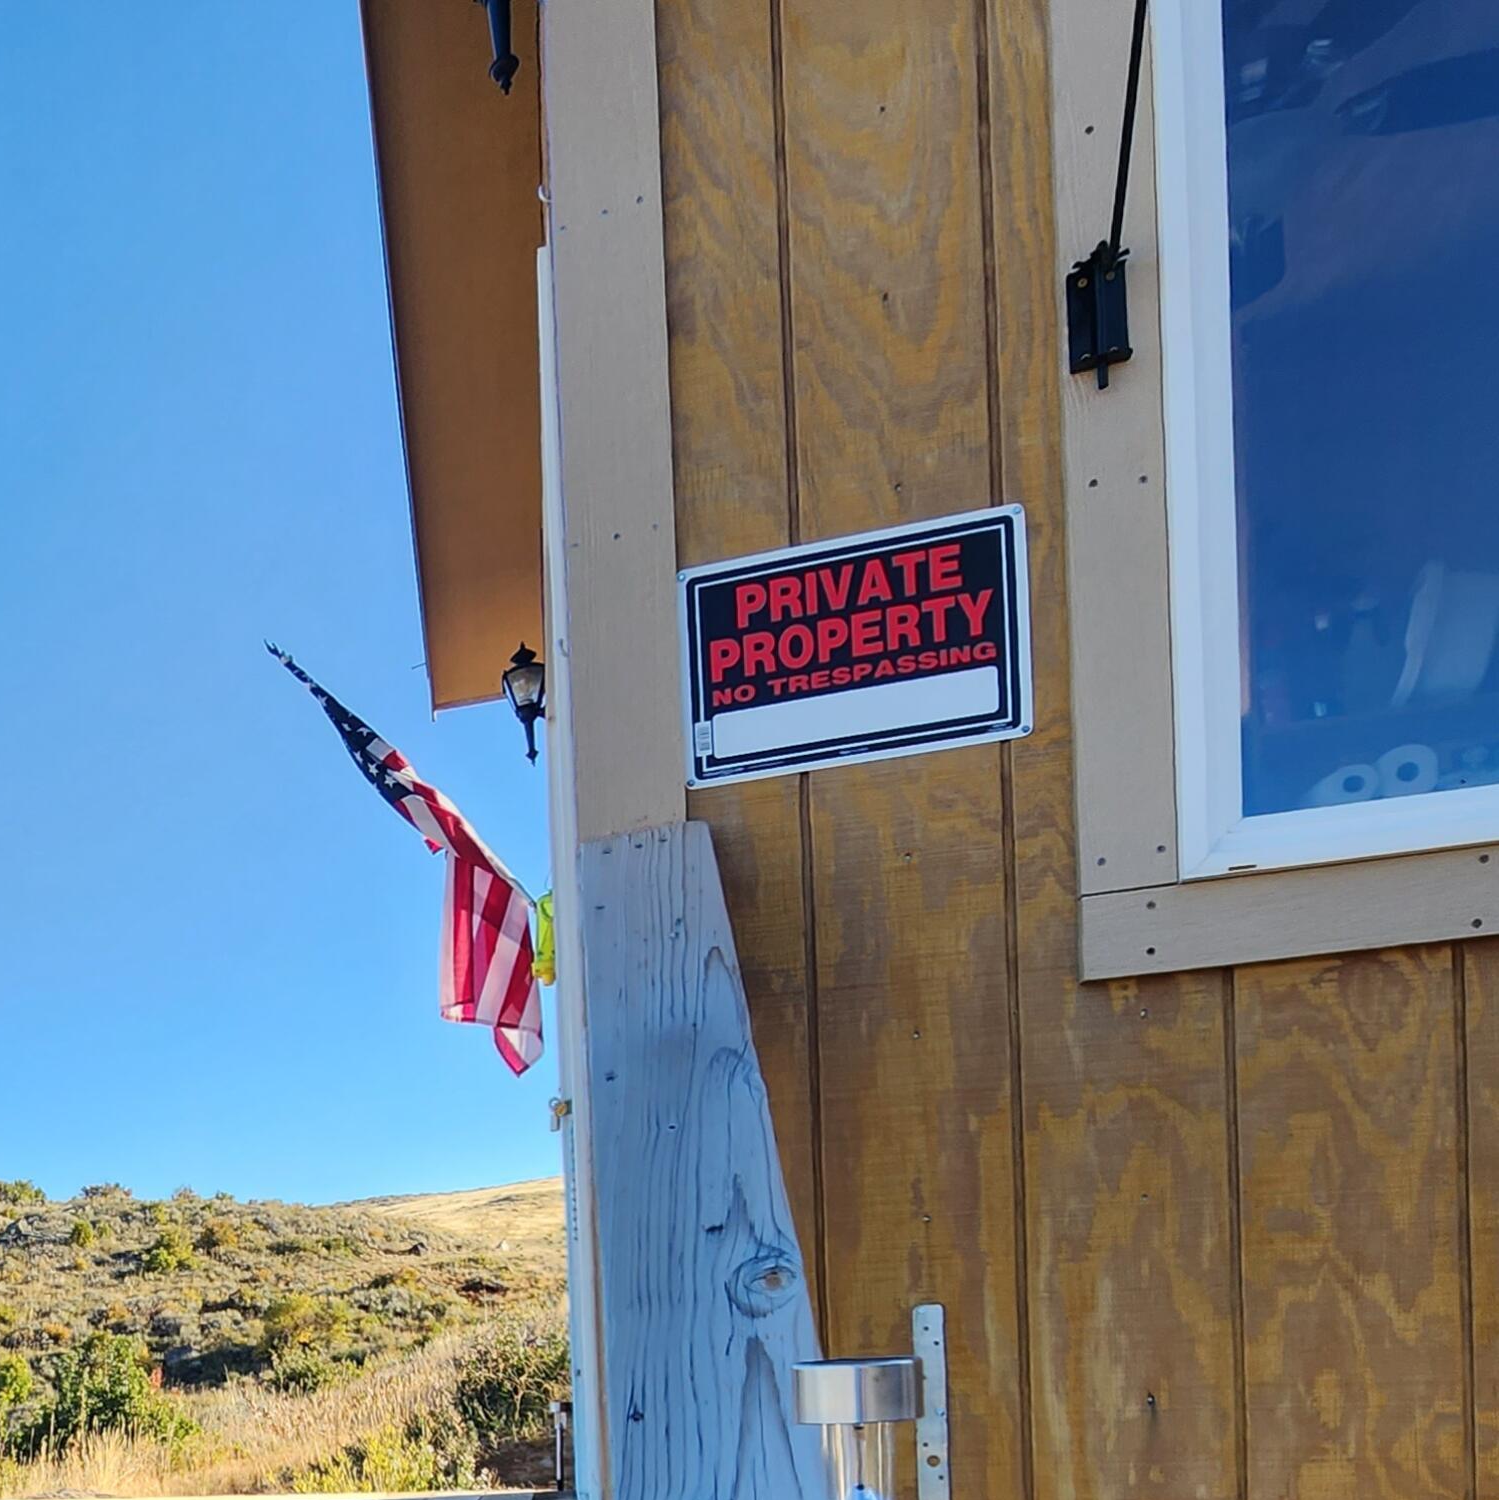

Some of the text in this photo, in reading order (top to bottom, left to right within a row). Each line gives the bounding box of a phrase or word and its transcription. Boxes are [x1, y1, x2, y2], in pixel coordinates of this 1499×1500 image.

[735, 543, 964, 629] PRIVATE
[709, 588, 994, 683] PROPERTY
[712, 641, 998, 707] NO TRESPASSING
